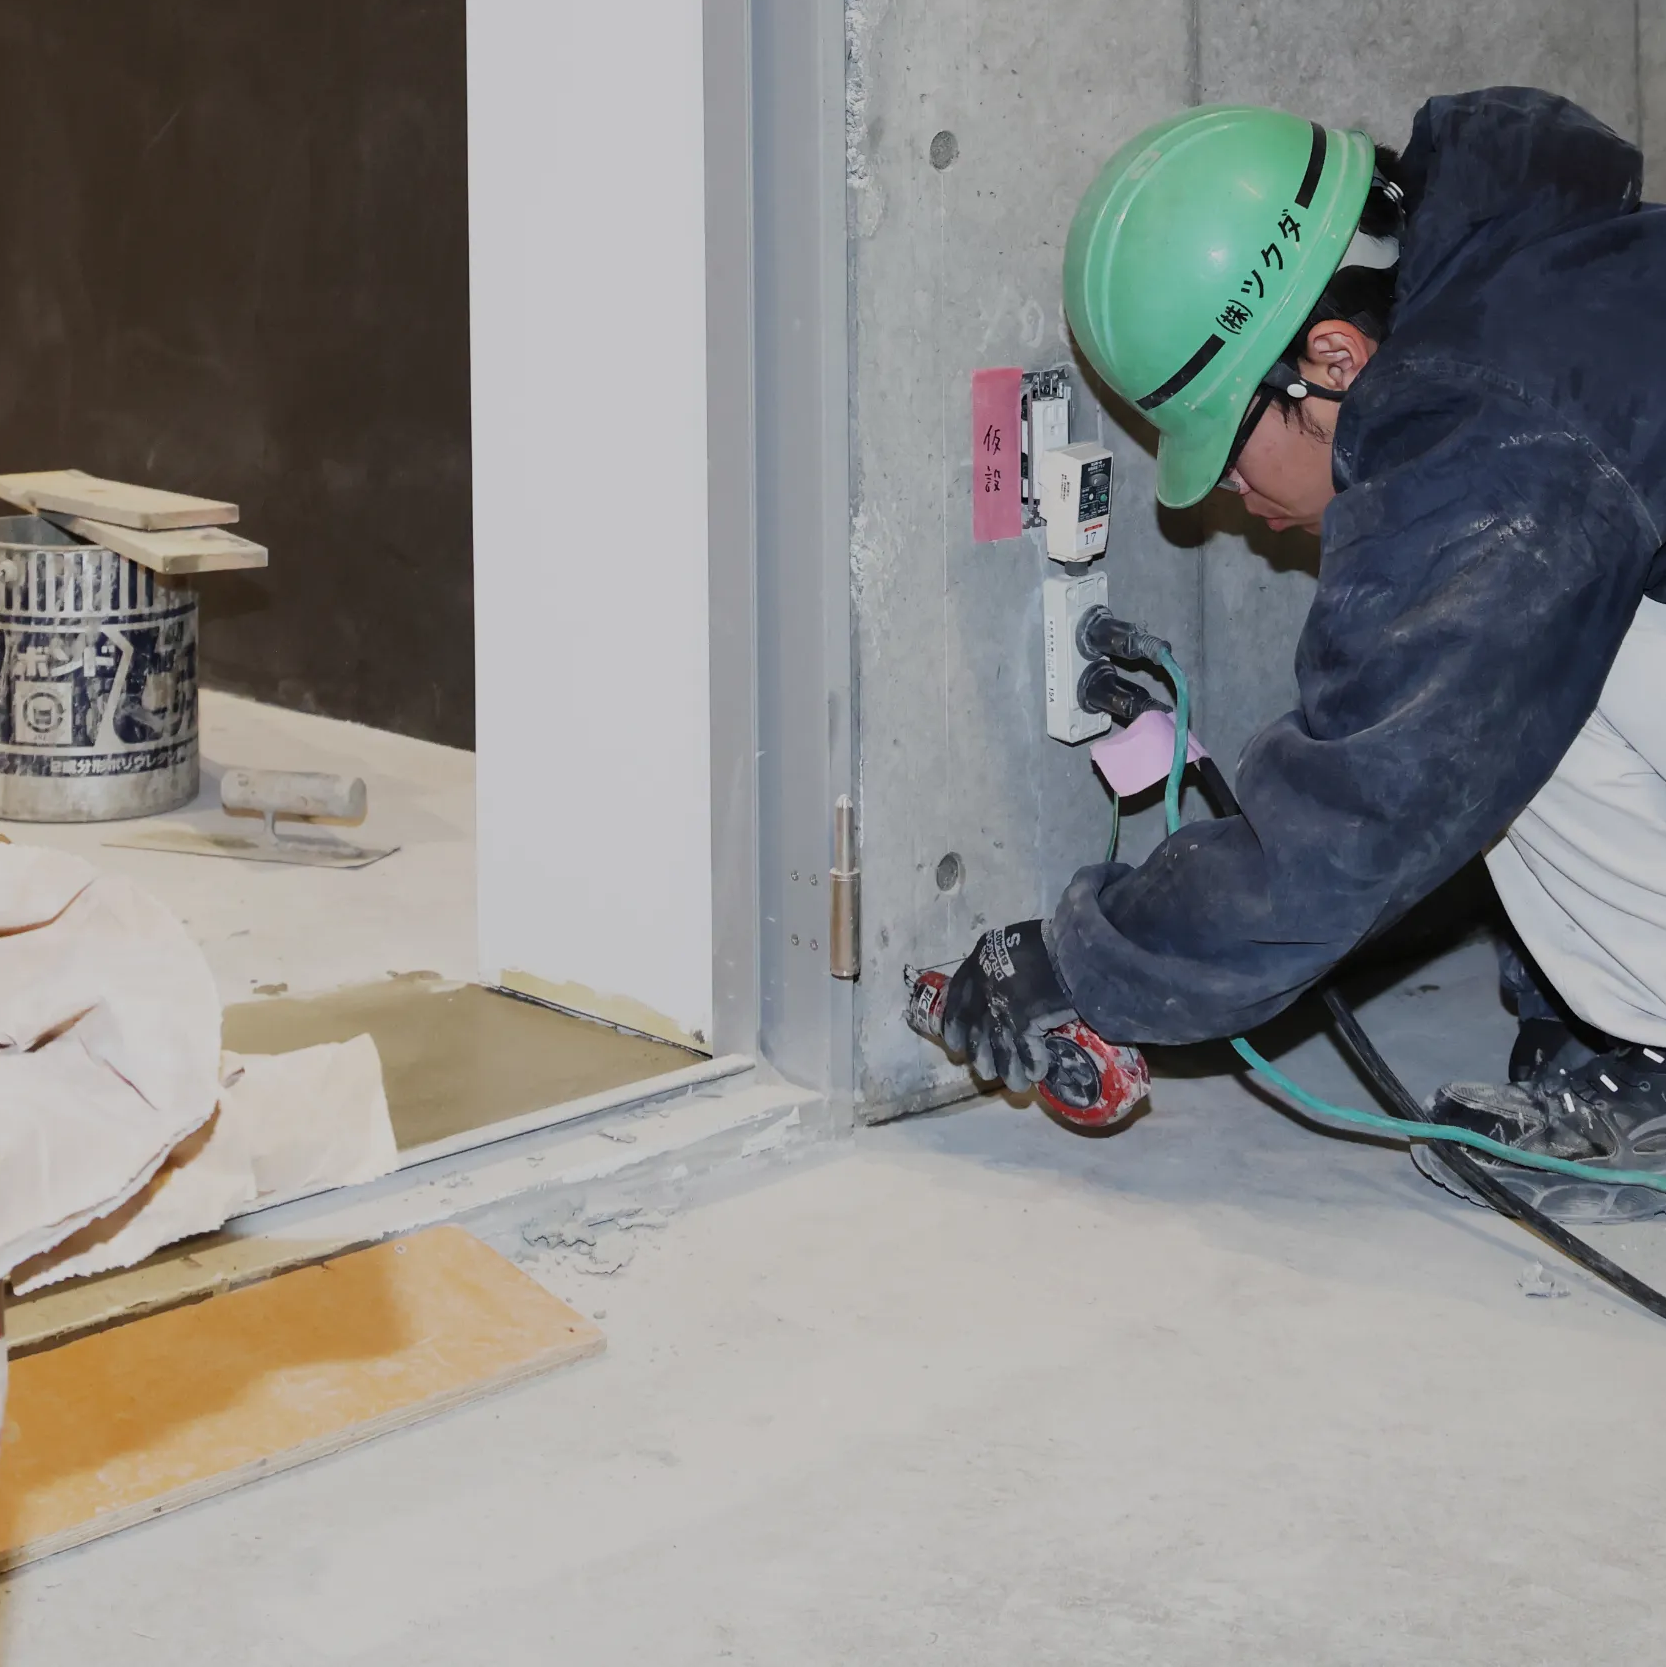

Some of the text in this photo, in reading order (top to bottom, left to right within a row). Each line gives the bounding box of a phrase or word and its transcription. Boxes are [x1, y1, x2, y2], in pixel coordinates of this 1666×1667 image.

[1216, 208, 1302, 335] (株)ツクダ
[983, 424, 1002, 493] 仮設
[1084, 531, 1097, 546] 17
[13, 644, 115, 677] ボンド
[1006, 933, 1021, 948] S
